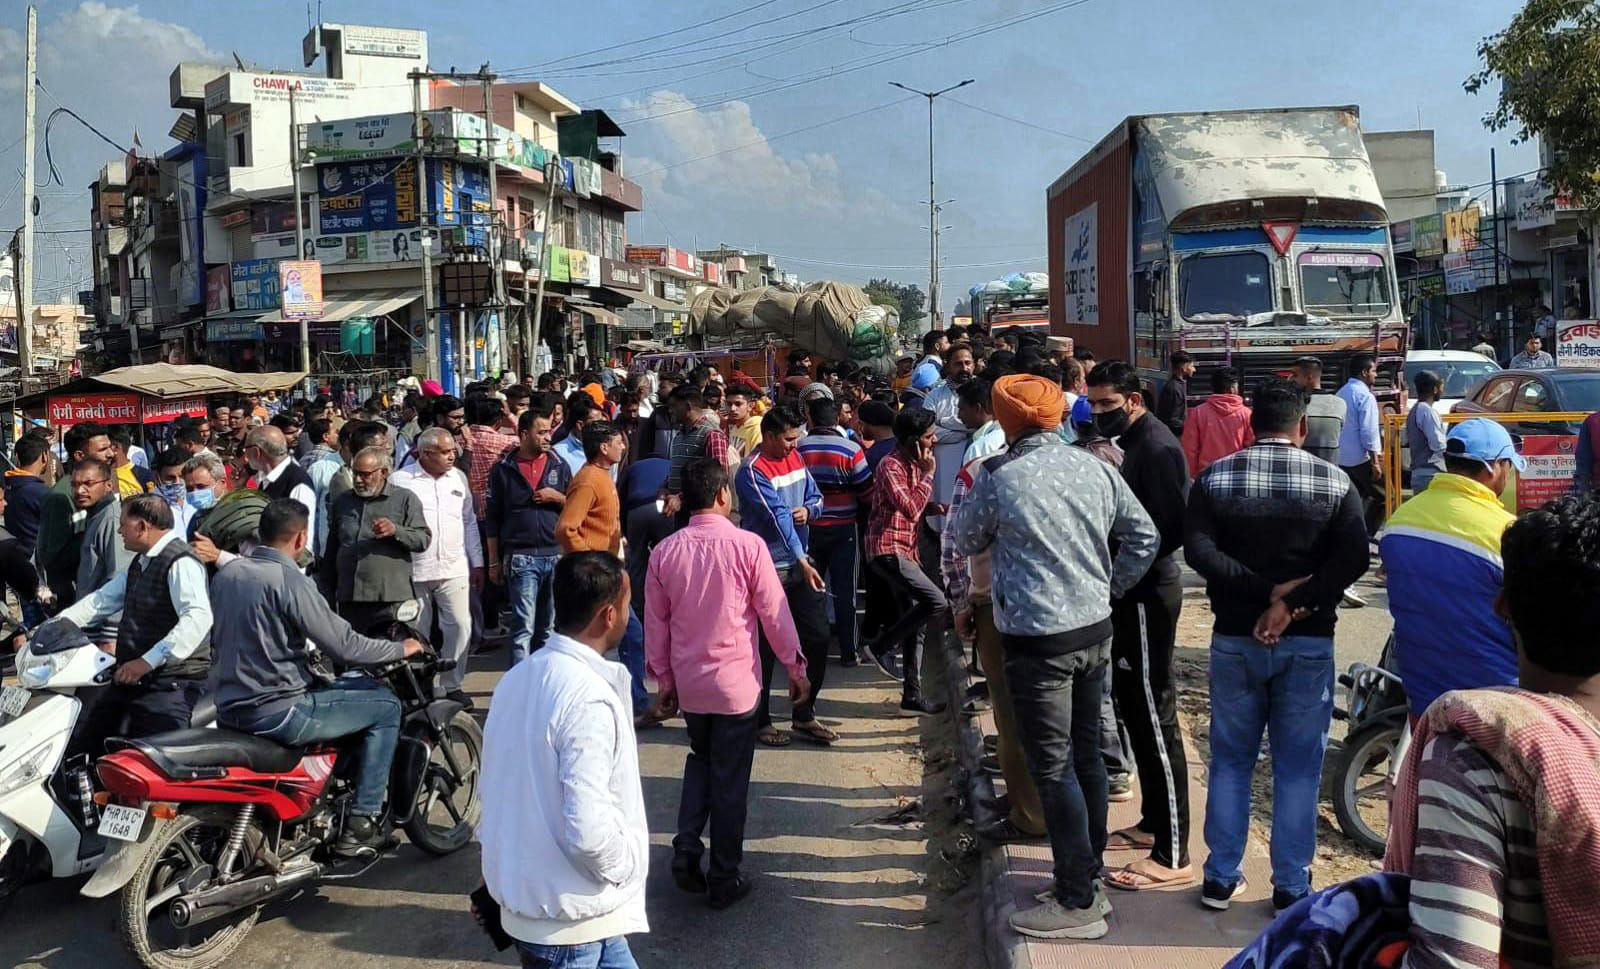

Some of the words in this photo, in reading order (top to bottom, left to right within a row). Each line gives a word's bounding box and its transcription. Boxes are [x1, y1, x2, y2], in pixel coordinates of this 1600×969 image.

[253, 78, 303, 91] CHAWLA
[1252, 338, 1286, 346] ASHOK
[1290, 338, 1334, 346] LEYLAND
[110, 806, 121, 820] HR
[121, 809, 130, 821] 04
[109, 822, 130, 836] 1648
